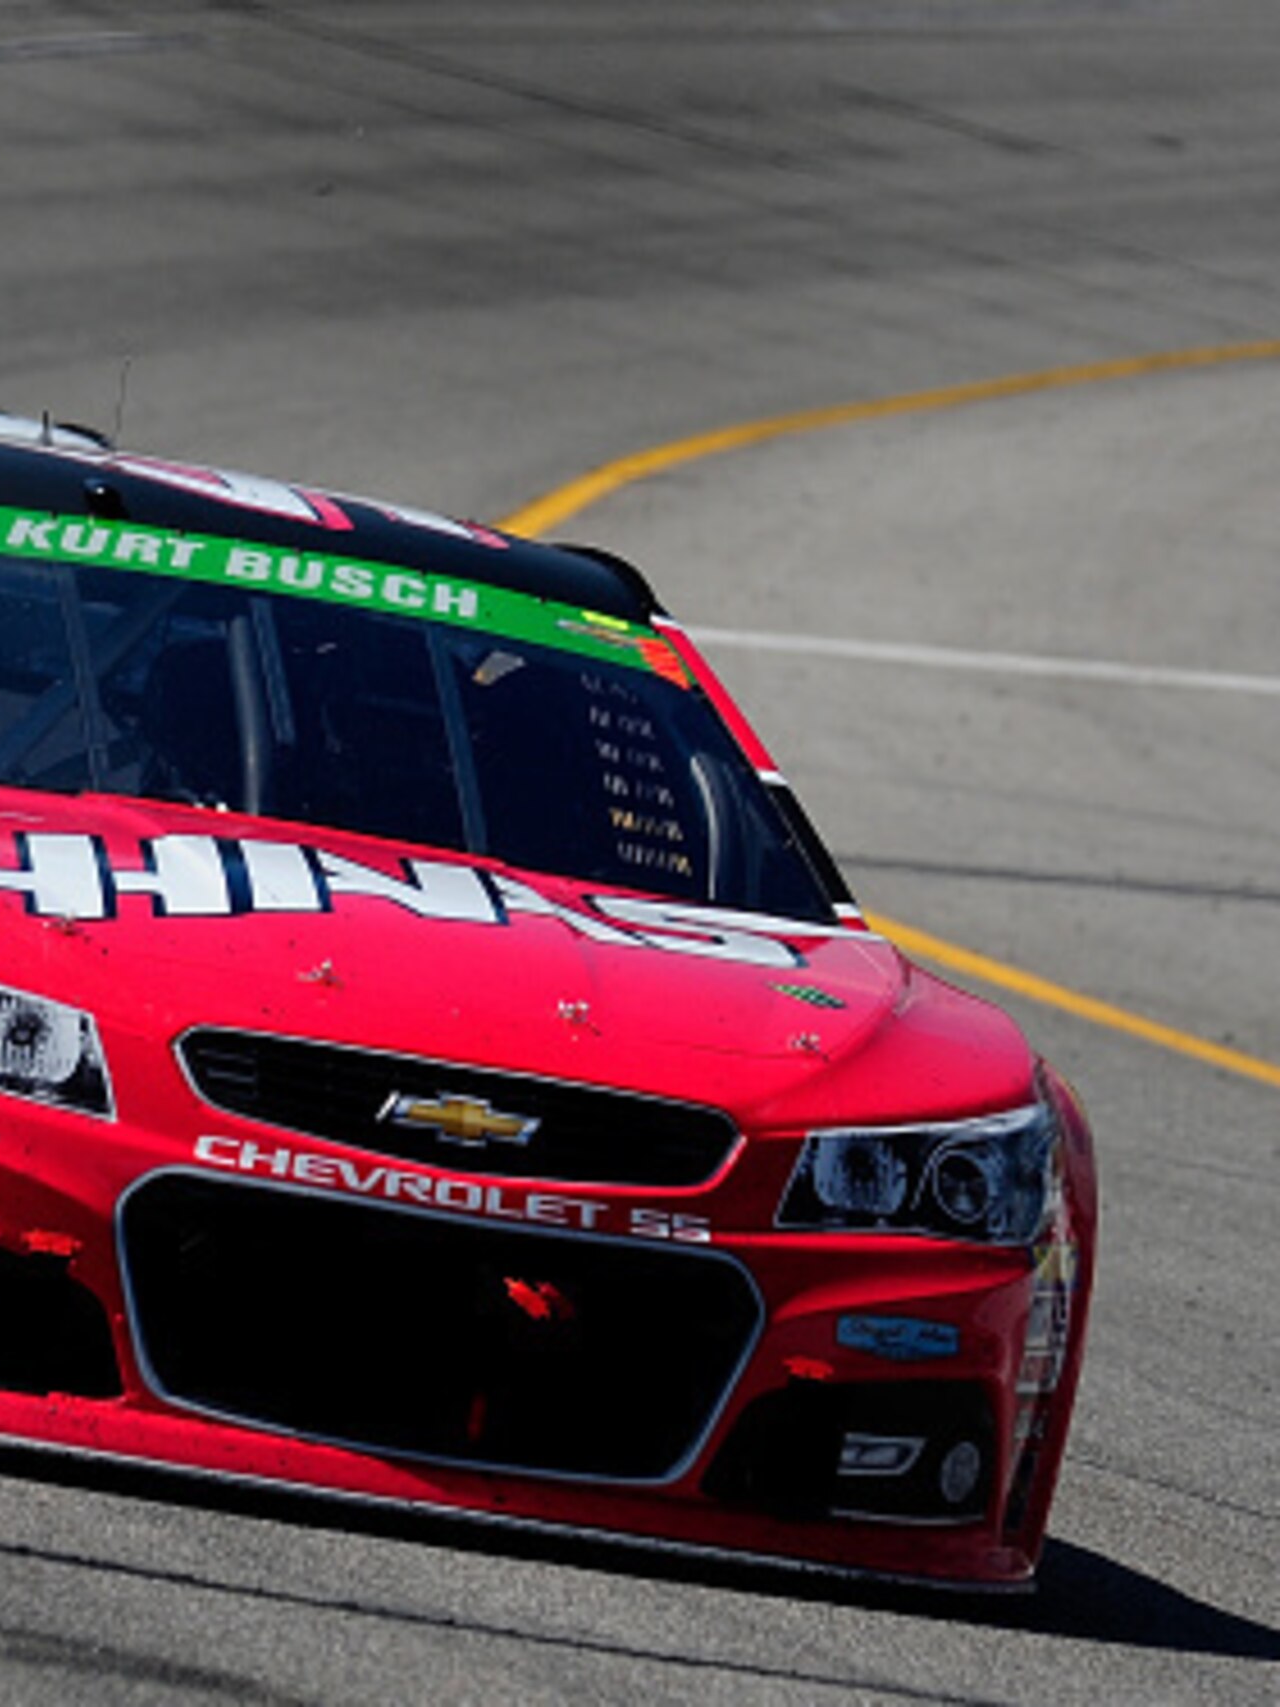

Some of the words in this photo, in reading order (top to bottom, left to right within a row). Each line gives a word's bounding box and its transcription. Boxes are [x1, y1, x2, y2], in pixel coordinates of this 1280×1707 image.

[5, 516, 206, 570] KURT
[223, 546, 480, 619] BUSCH
[192, 1135, 610, 1229] CHEVROLET
[628, 1207, 712, 1243] SS
